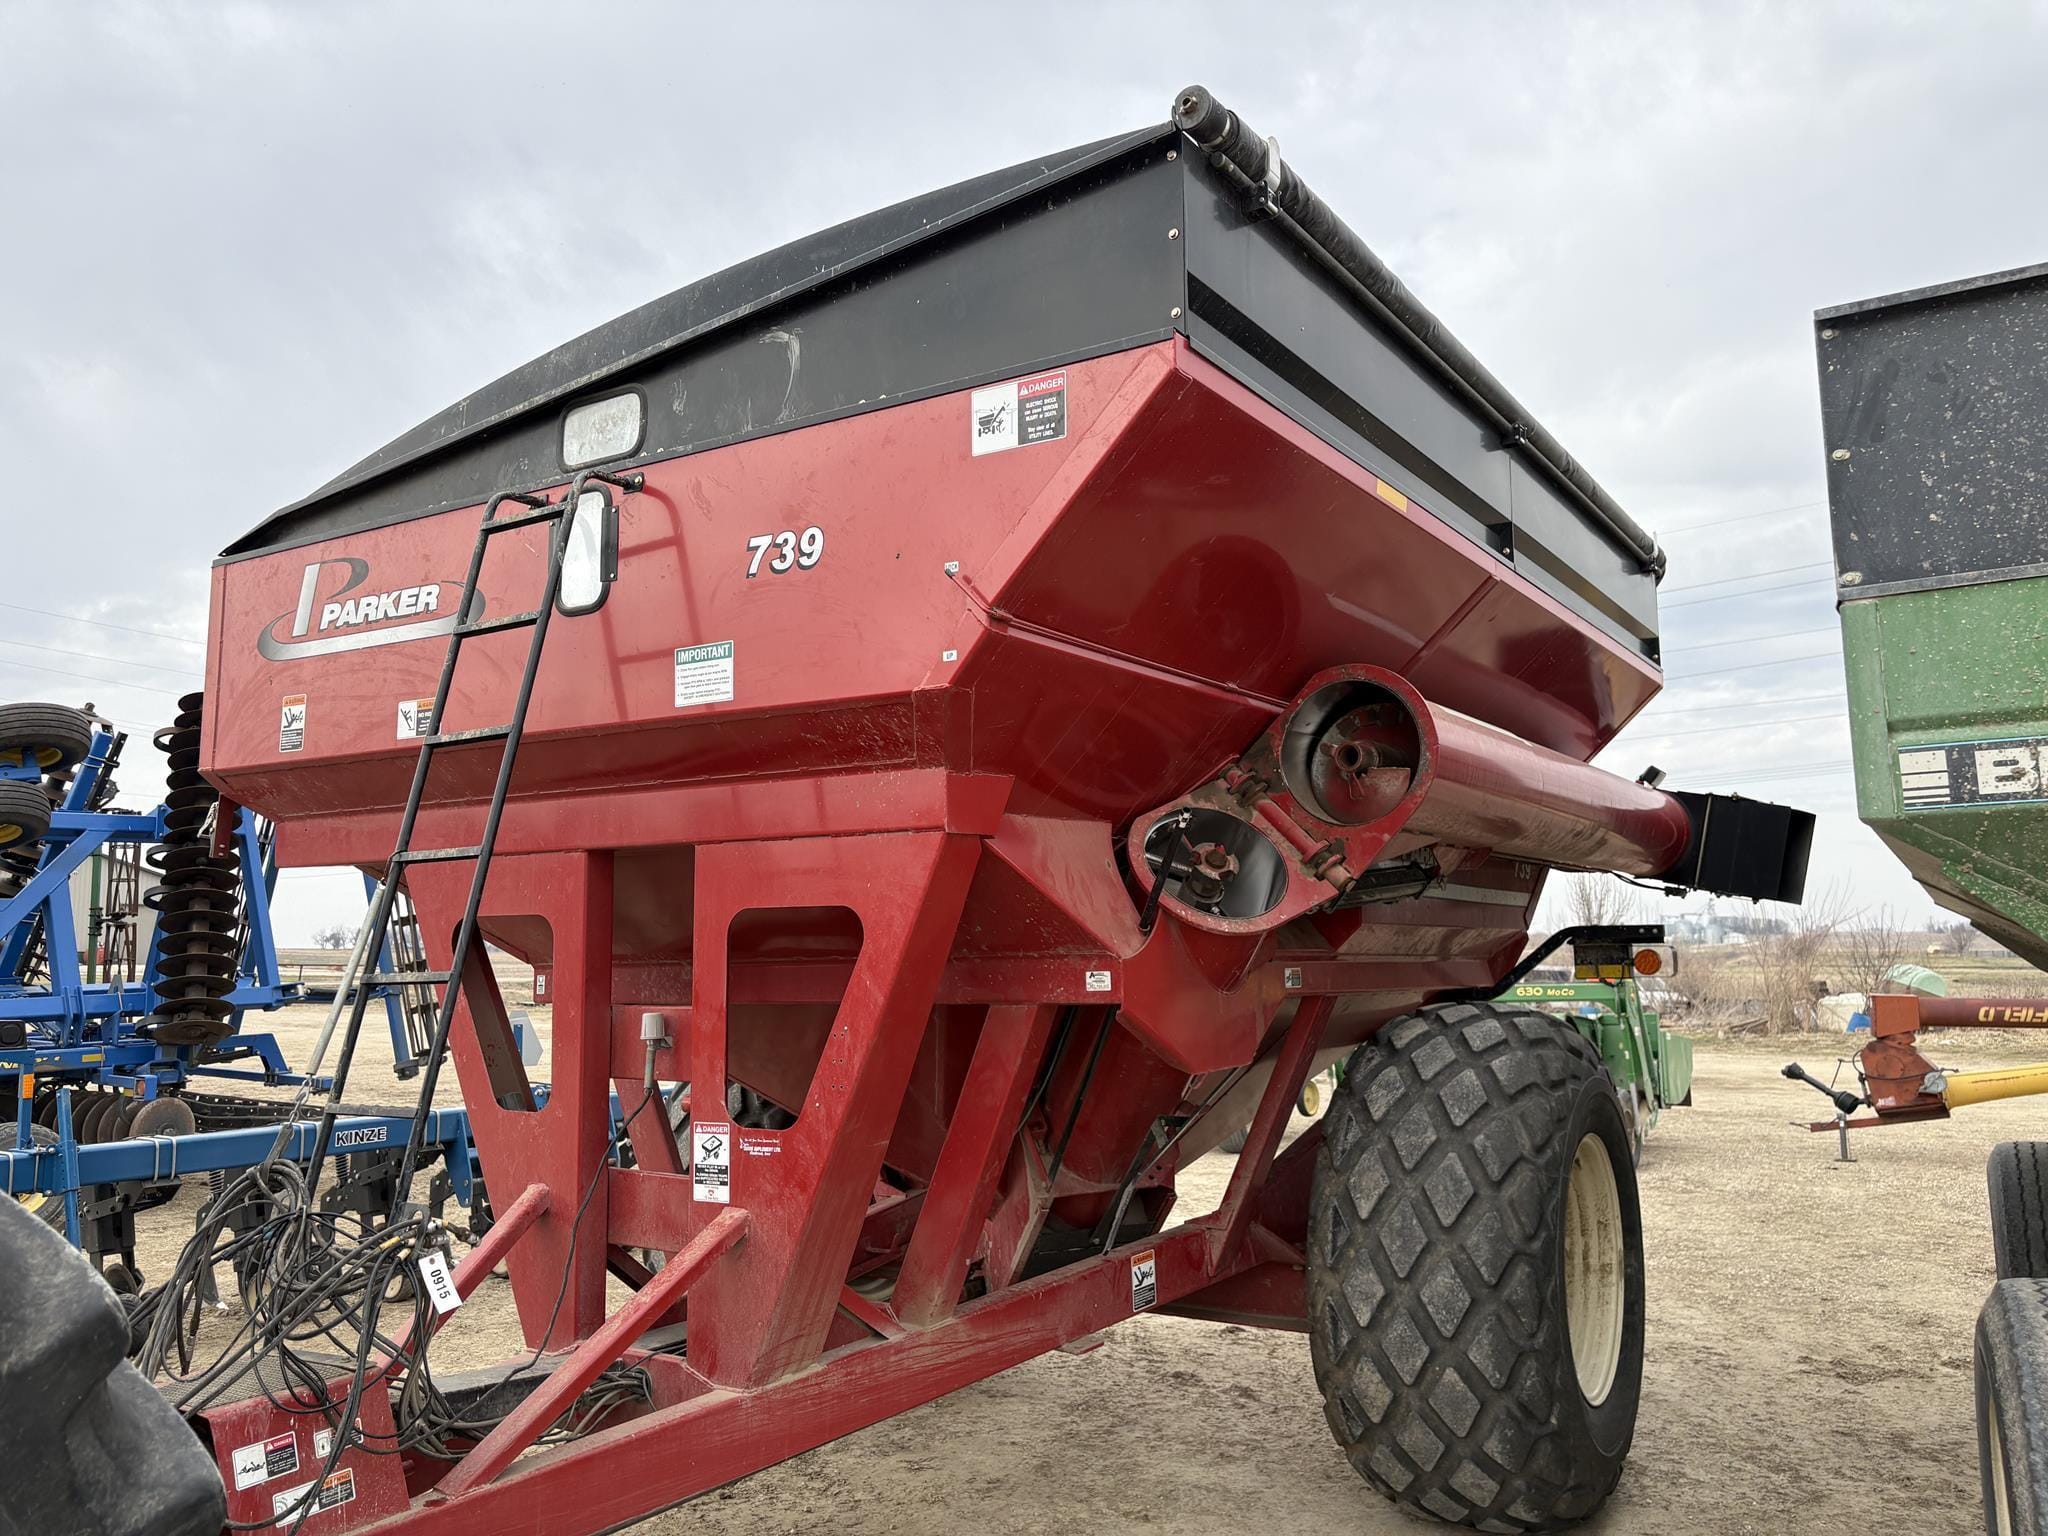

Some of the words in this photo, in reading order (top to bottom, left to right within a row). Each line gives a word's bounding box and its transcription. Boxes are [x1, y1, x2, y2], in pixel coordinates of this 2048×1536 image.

[1028, 377, 1064, 393] DANGER
[745, 525, 825, 579] 739
[318, 583, 441, 633] PARKER
[677, 644, 731, 663] IMPORTANT
[1516, 986, 1544, 997] 630
[1546, 988, 1575, 997] MoCo
[335, 1127, 387, 1147] KINZE
[702, 1125, 728, 1134] DANGER
[430, 1269, 451, 1299] 0915
